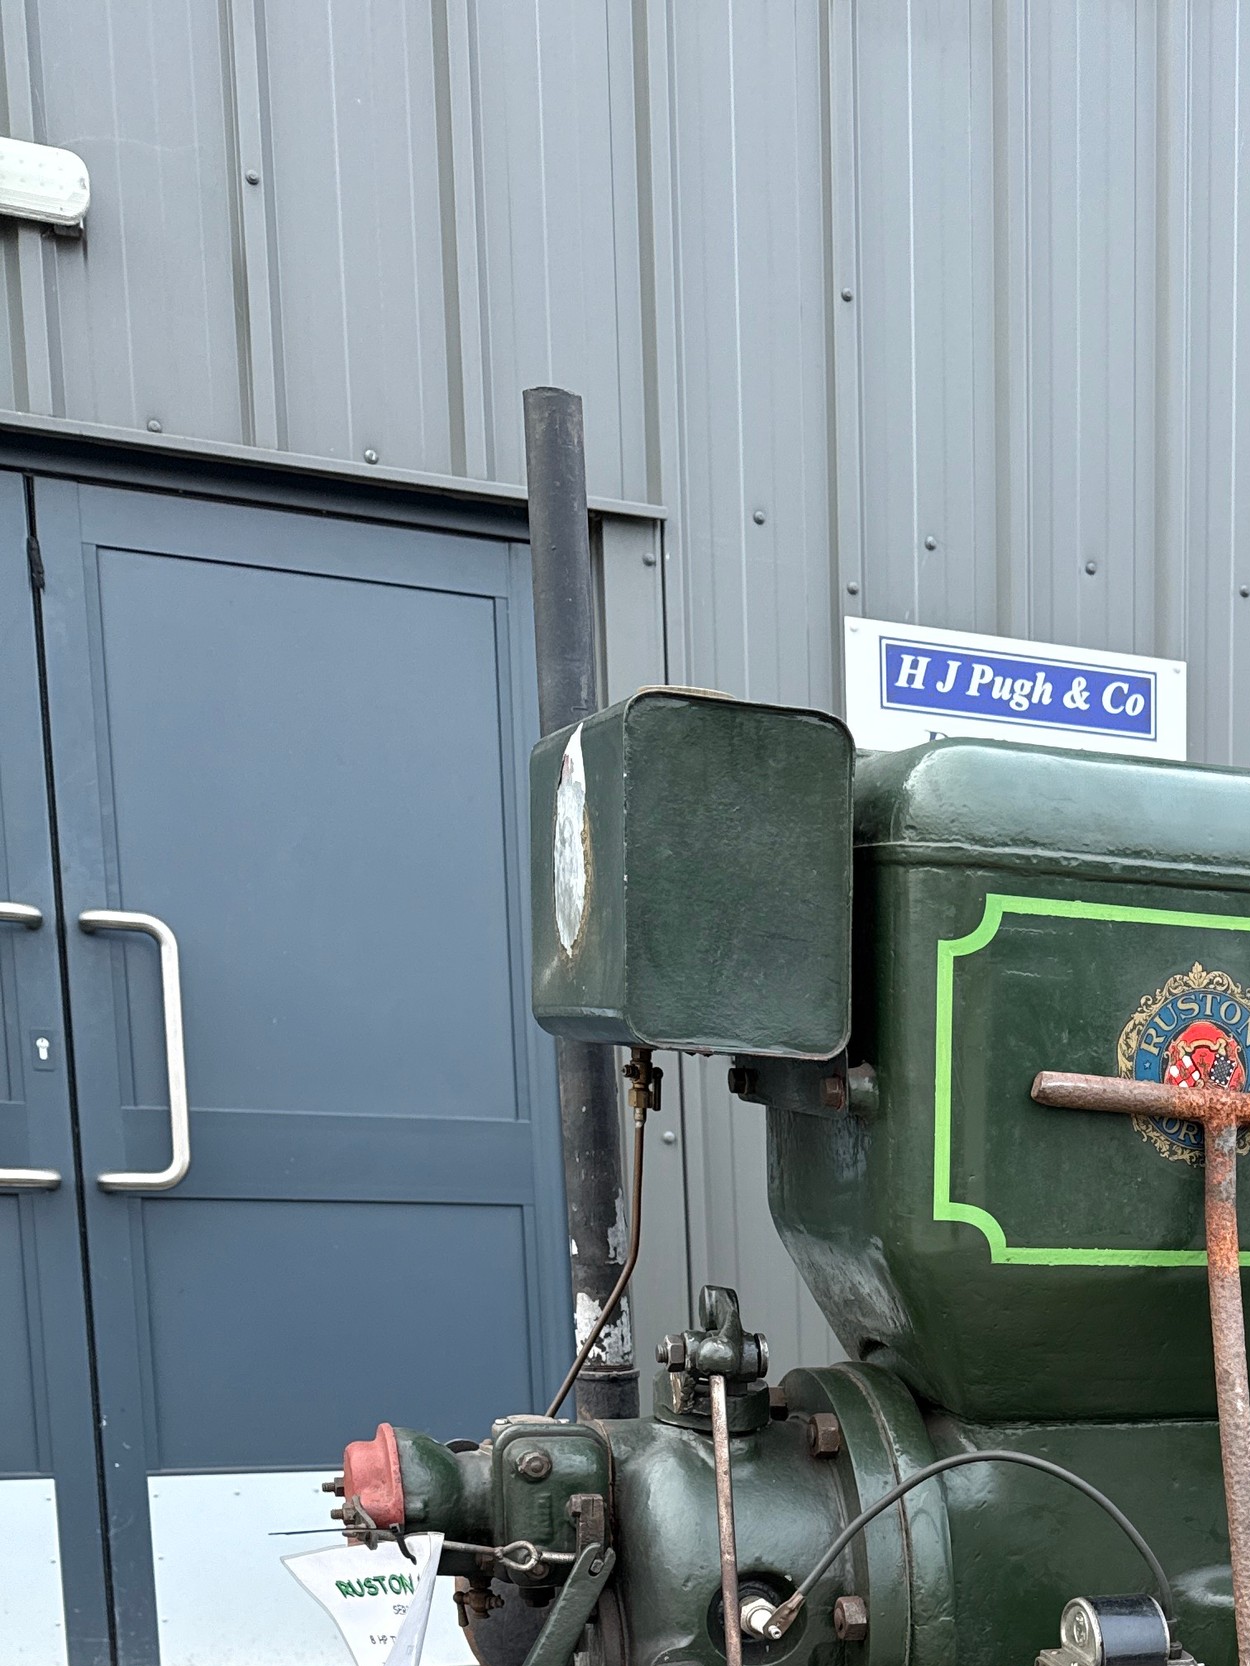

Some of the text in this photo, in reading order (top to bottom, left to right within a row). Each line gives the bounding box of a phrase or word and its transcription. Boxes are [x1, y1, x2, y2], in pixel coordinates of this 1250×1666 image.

[894, 653, 1146, 717] H J Pugh & Co
[335, 1573, 415, 1599] RUSTON
